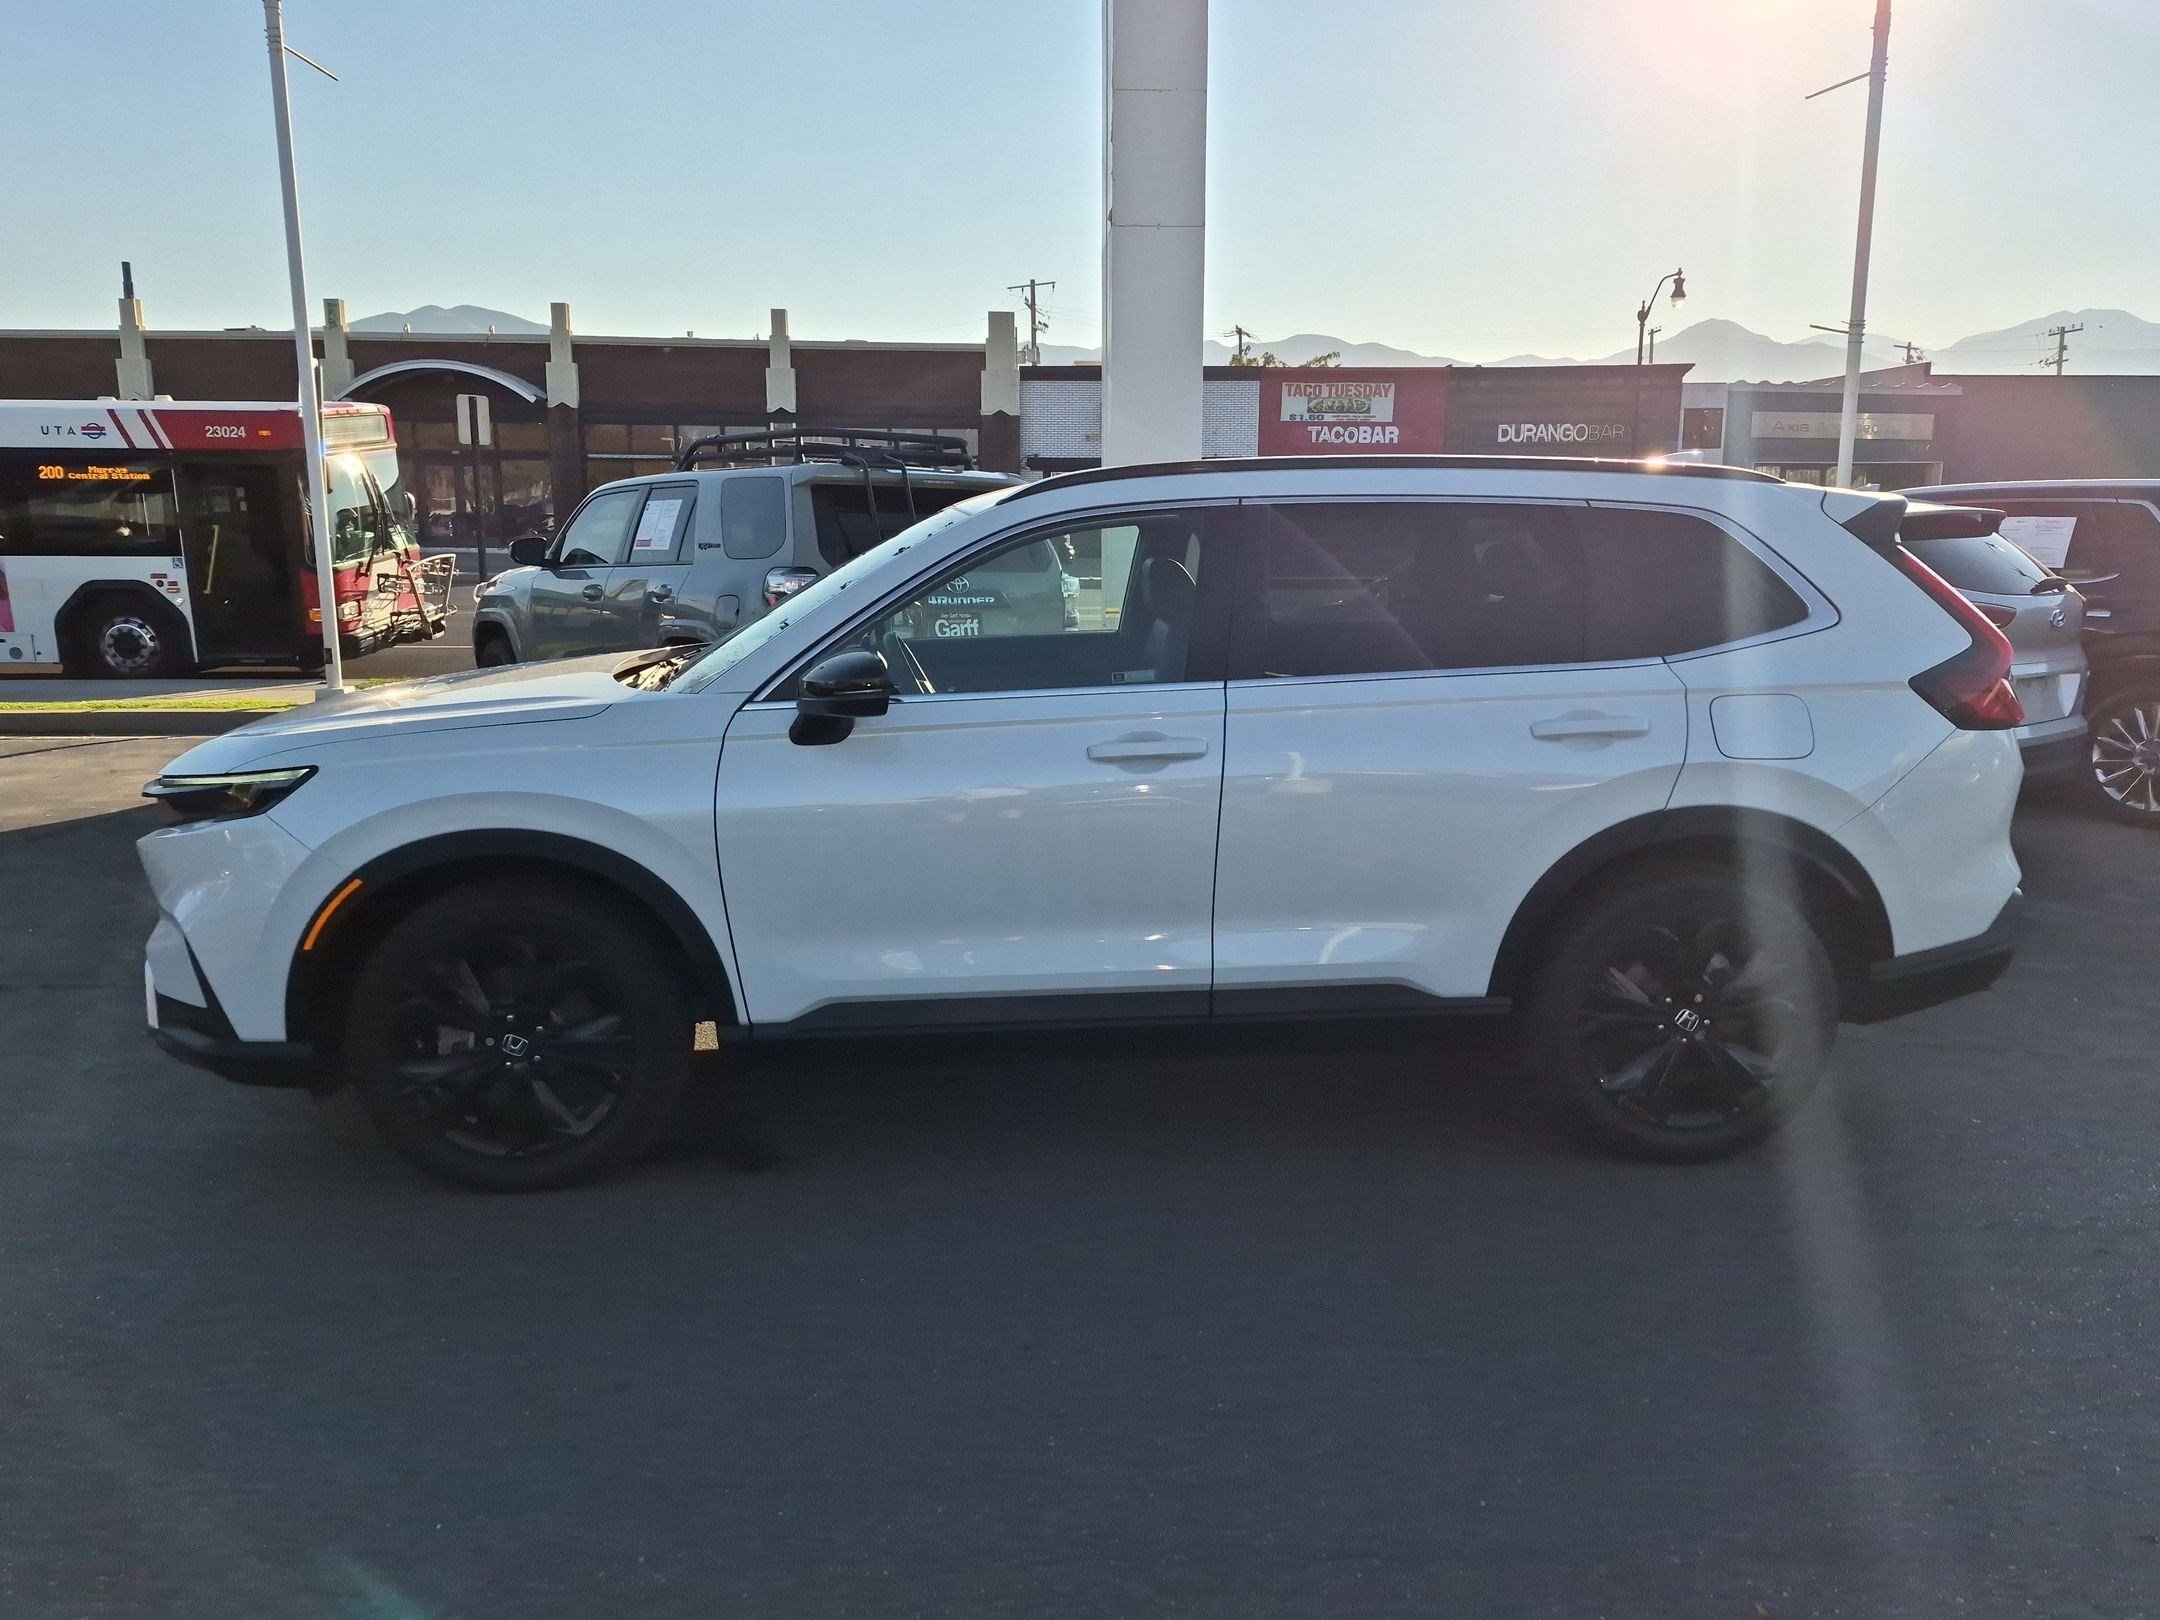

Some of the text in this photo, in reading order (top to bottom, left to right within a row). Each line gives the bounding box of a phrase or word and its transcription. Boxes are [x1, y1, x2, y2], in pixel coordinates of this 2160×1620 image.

[1285, 383, 1393, 397] TACO TUESDAY
[40, 425, 76, 436] UTA
[205, 426, 246, 438] 23024
[1307, 425, 1400, 443] TACOBAR
[38, 465, 65, 479] 200
[87, 466, 128, 475] Murray
[112, 472, 151, 480] Station
[935, 618, 979, 637] Garff
